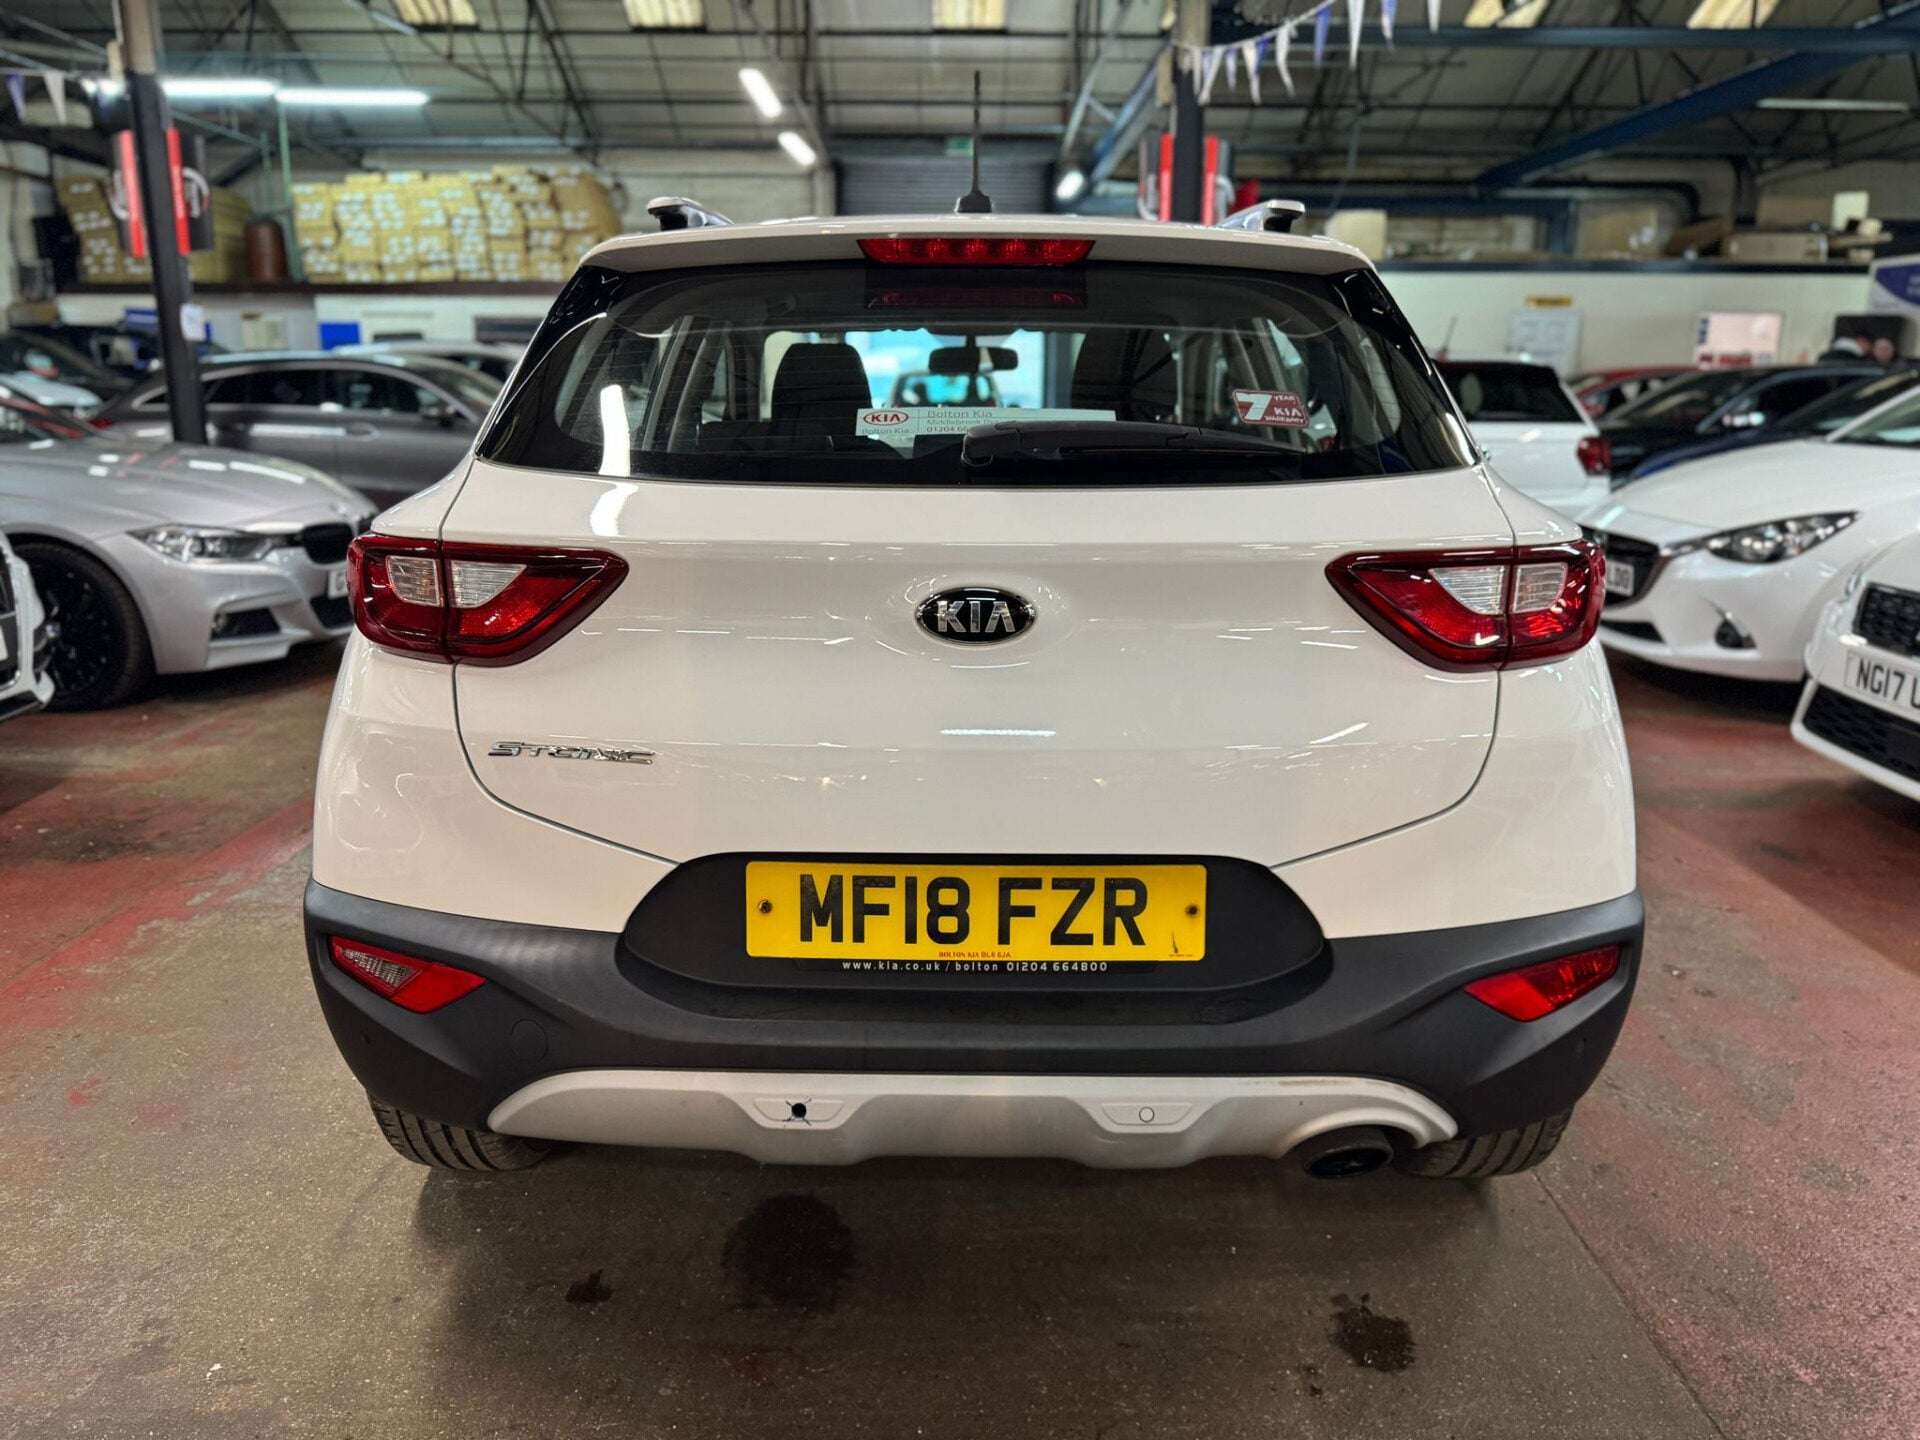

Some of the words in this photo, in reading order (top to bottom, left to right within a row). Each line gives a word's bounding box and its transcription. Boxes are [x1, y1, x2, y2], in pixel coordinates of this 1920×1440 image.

[871, 414, 901, 422] KIA
[927, 410, 968, 418] Bolton
[1236, 392, 1272, 420] 7
[1274, 407, 1302, 416] KIA
[937, 600, 1016, 633] KIA
[1857, 658, 1906, 702] NG17
[488, 741, 656, 765] STONIC
[799, 873, 970, 945] MF18
[998, 876, 1149, 947] FZR
[842, 960, 940, 970] www.kia.co.uk
[955, 961, 998, 971] bolton
[1006, 962, 1047, 971] 01204
[1052, 962, 1108, 972] 664800
